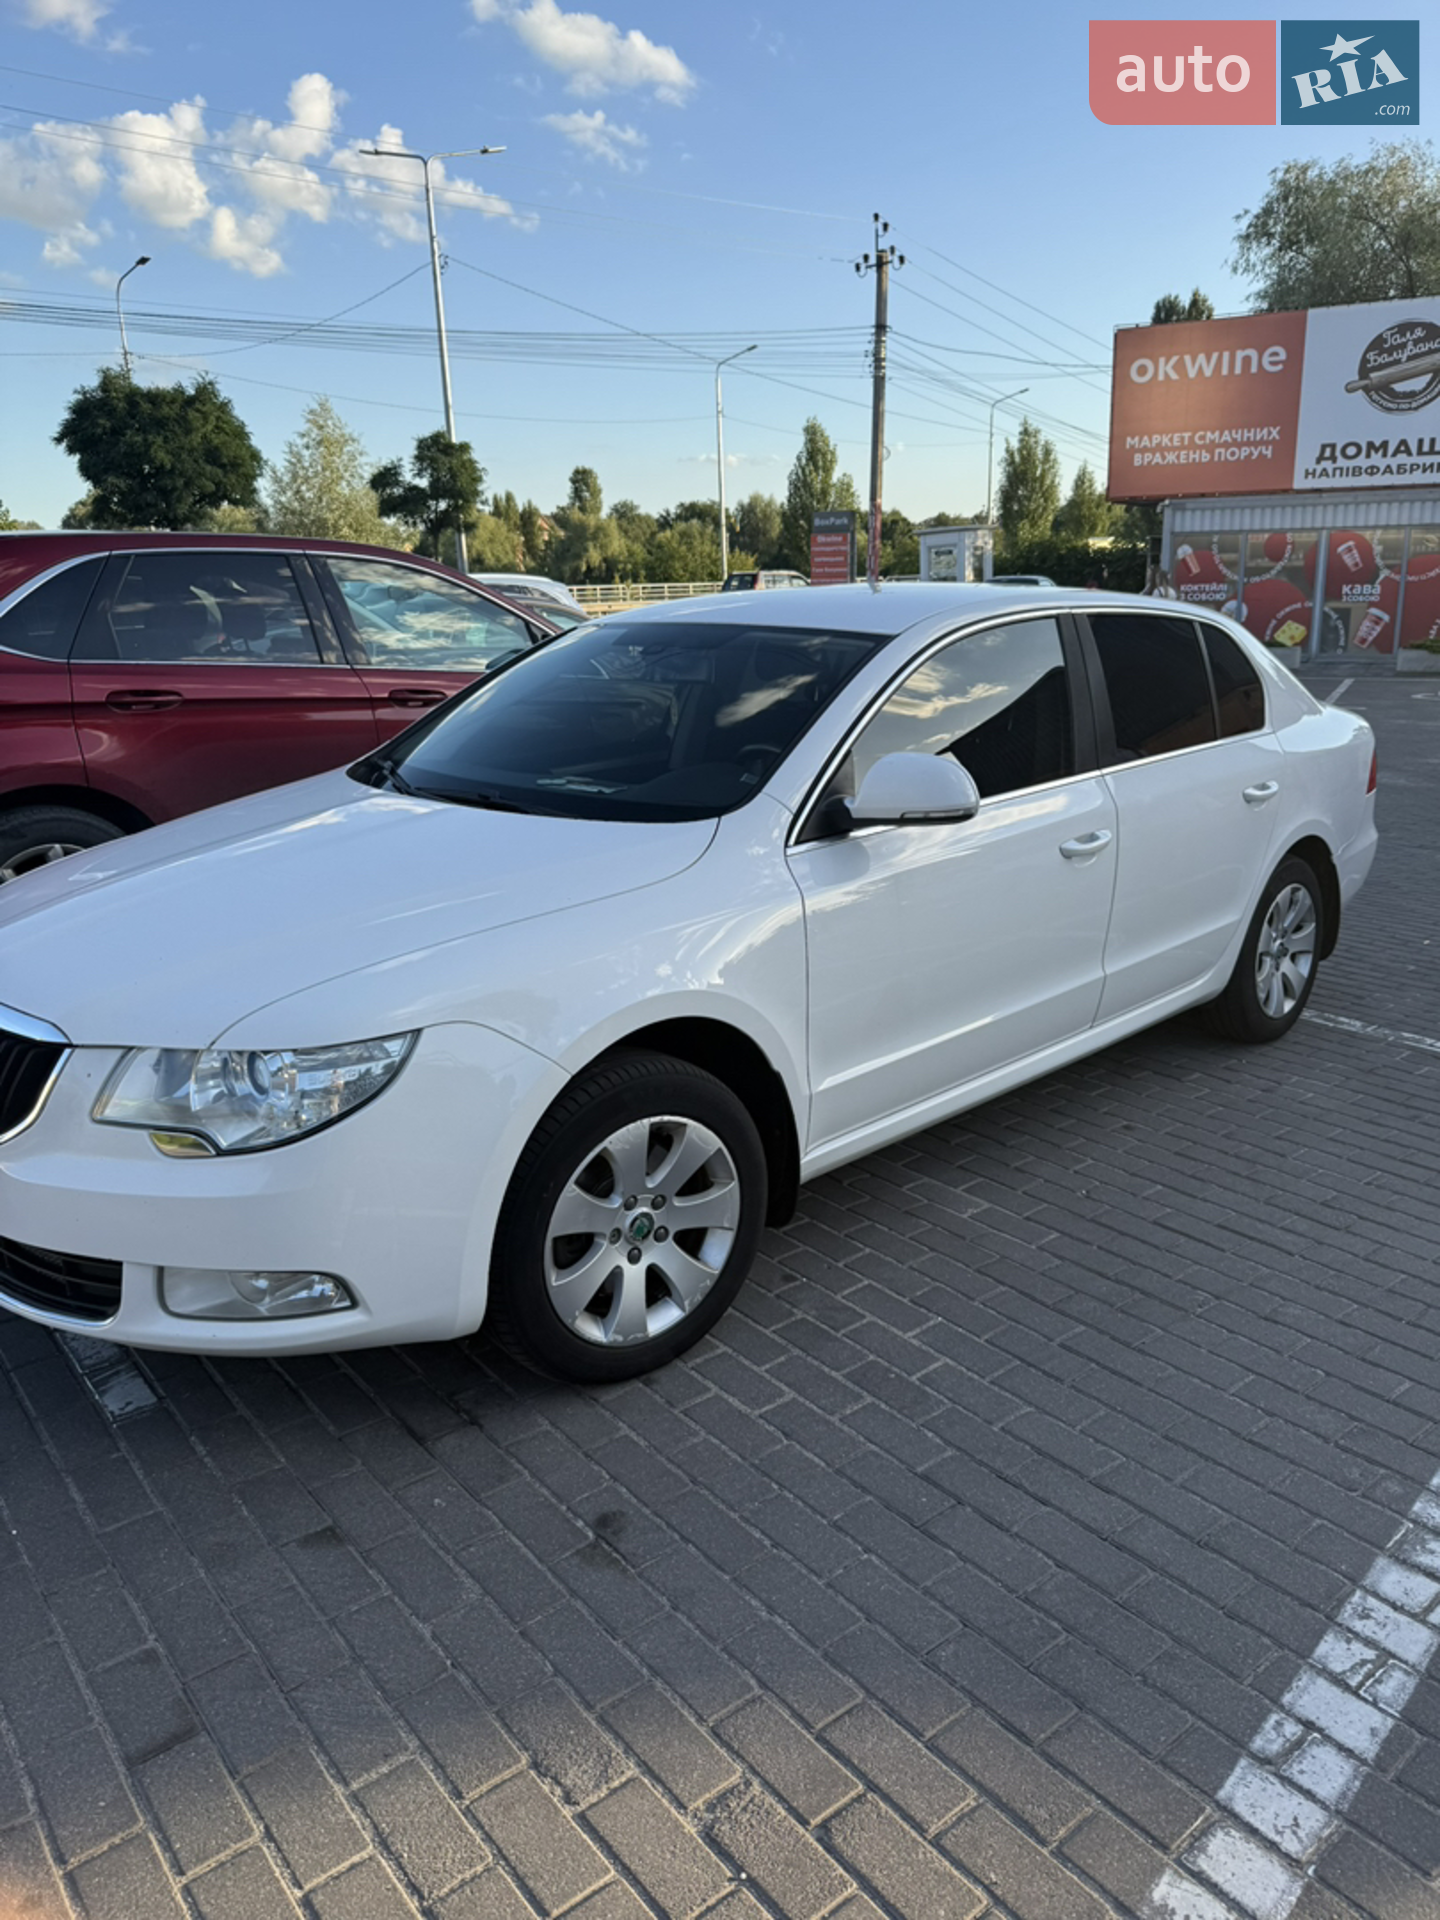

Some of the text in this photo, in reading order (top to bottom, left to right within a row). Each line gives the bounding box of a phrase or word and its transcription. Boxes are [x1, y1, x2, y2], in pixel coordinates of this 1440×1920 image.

[1126, 426, 1281, 449] МАРКЕТ СМАЧНИХ
[1133, 446, 1273, 467] ВРАЖЕНЬ ПОРУЧ
[1180, 582, 1228, 592] КОКТЕЙЛІ
[1187, 592, 1226, 601] СОБОЮ
